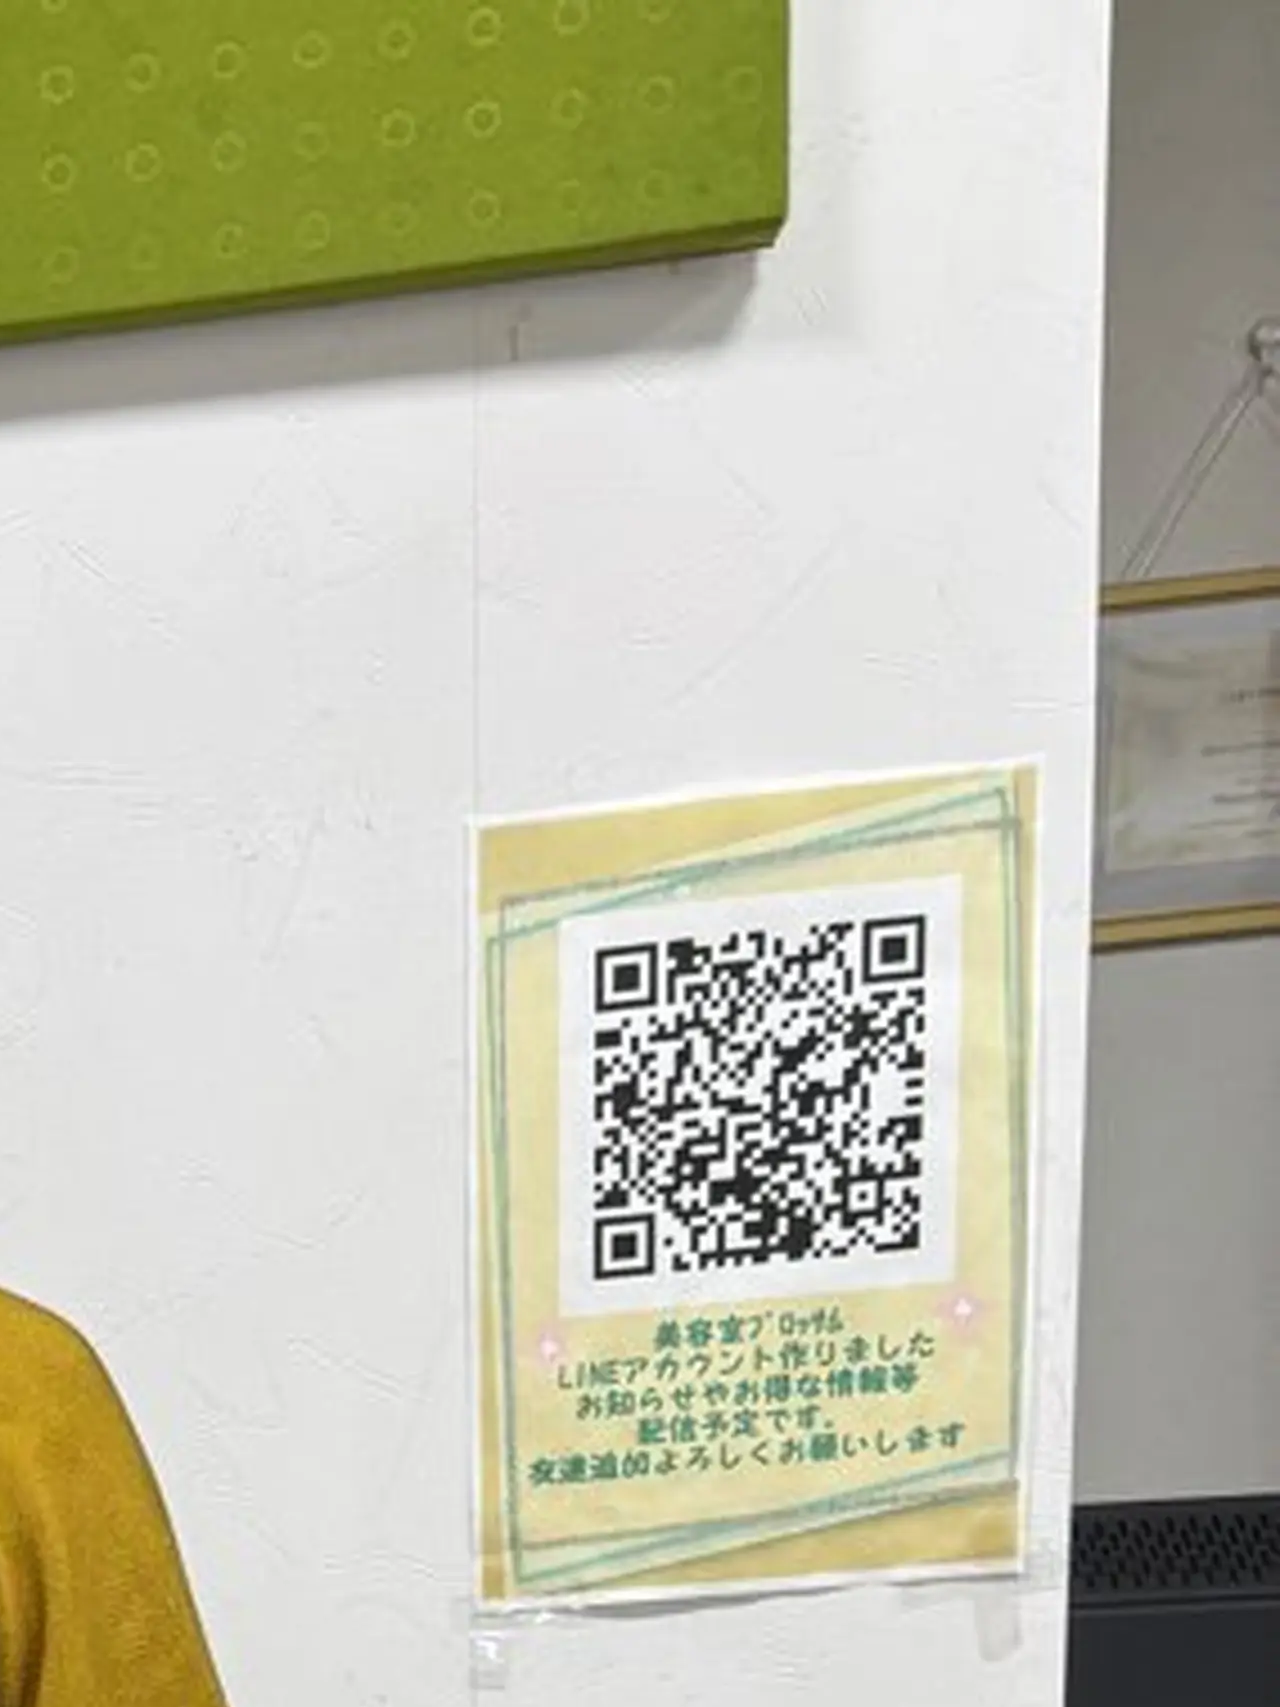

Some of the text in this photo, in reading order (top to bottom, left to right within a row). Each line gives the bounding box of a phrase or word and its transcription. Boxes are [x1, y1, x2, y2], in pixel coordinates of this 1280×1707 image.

[557, 1332, 935, 1390] LINEアカウント作りました
[576, 1364, 919, 1419] お知らせやお得な情報等
[529, 1422, 965, 1485] 友達追加よろしくお願いします
[639, 1406, 835, 1445] 配信予定です。
